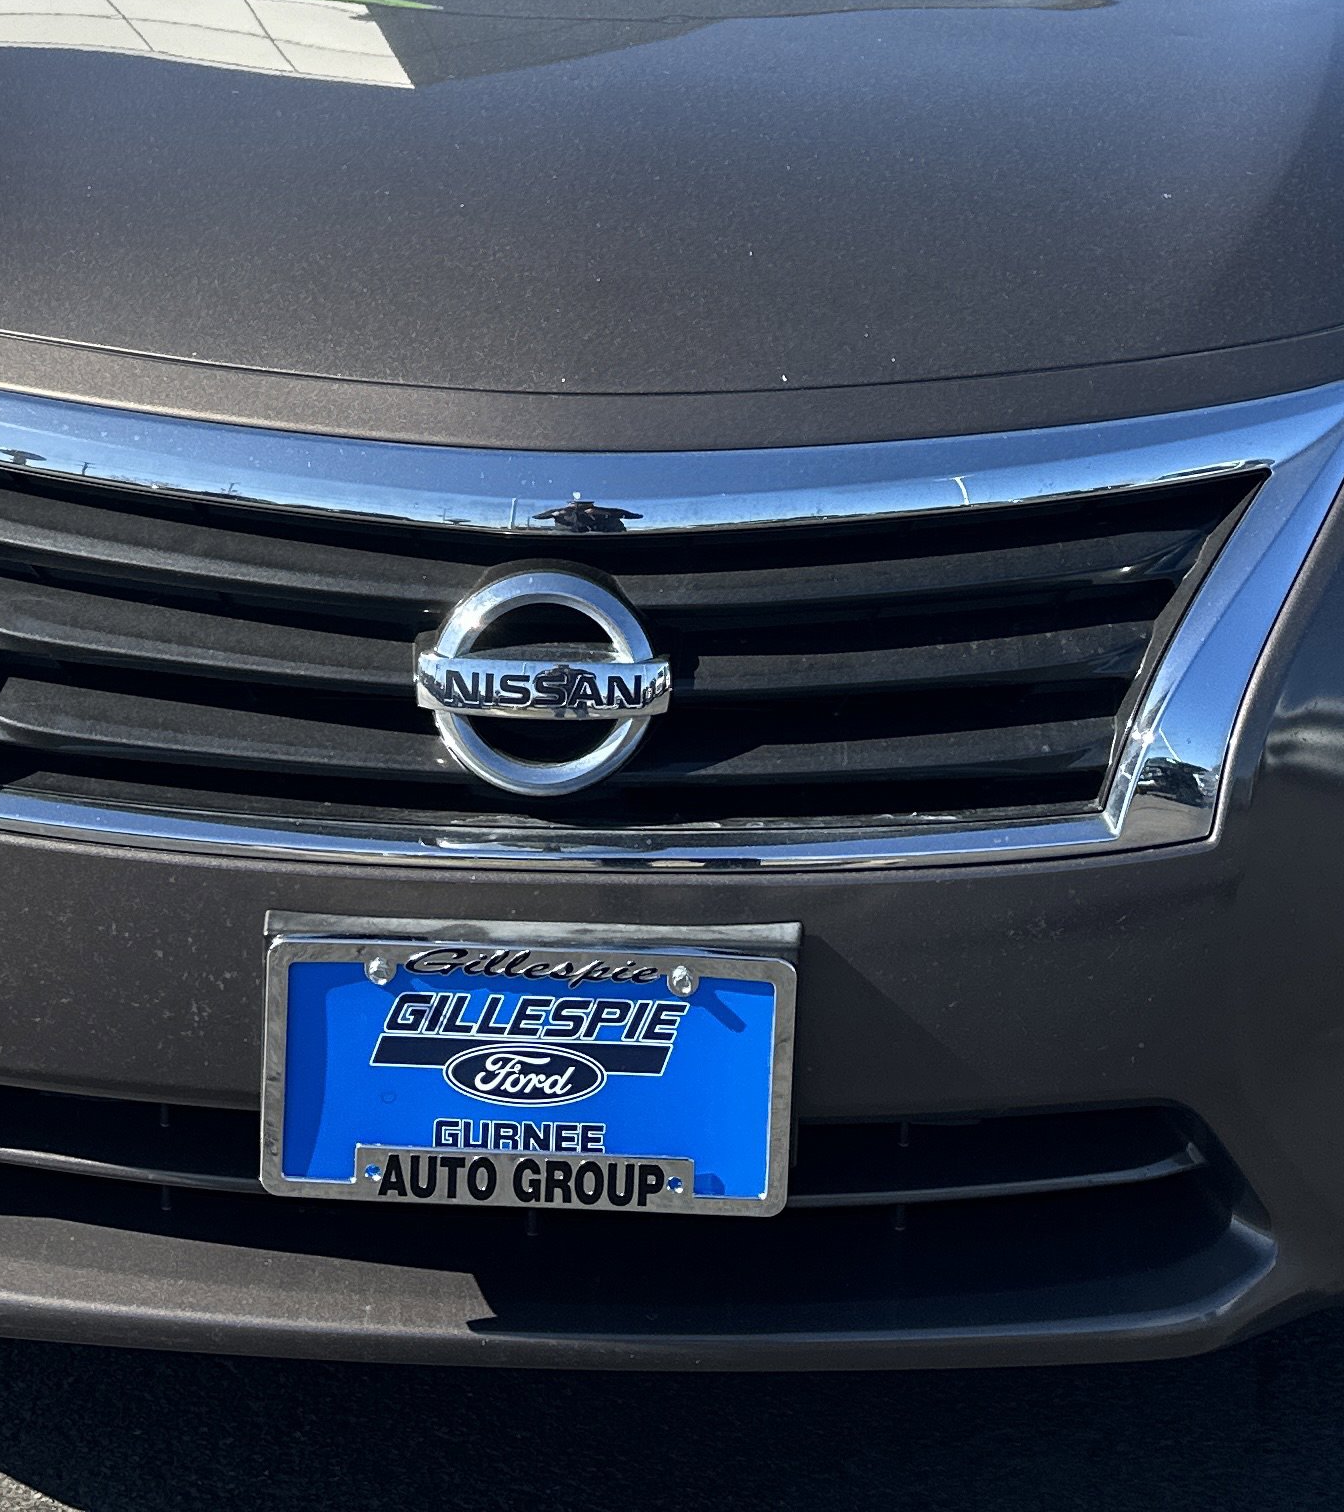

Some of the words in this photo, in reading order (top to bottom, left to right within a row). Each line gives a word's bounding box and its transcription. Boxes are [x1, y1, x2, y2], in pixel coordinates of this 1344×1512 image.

[443, 669, 644, 710] NISSAN
[404, 947, 659, 989] Gillespie
[383, 991, 690, 1043] GILLESPIE
[473, 1052, 576, 1096] Ford
[432, 1118, 606, 1154] GURNEE
[377, 1153, 498, 1202] AUTO
[512, 1157, 665, 1207] GROUP
